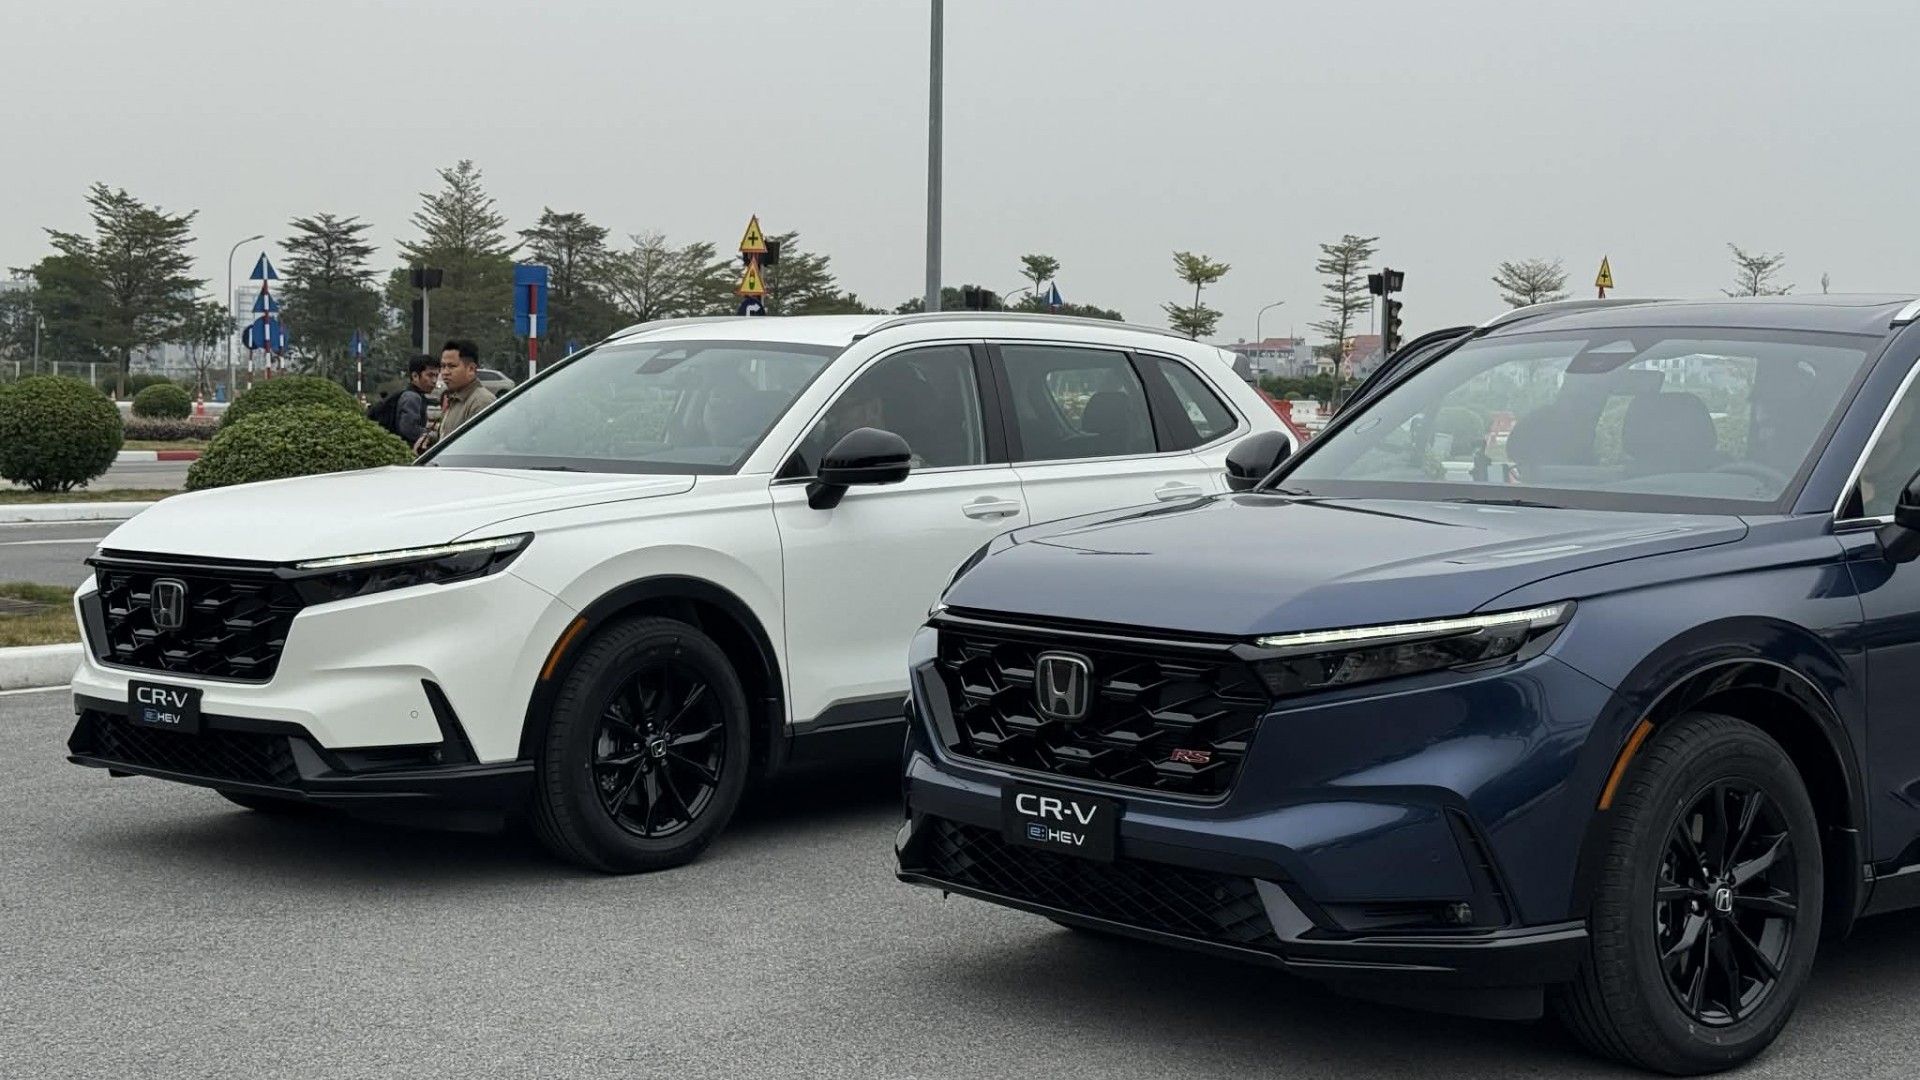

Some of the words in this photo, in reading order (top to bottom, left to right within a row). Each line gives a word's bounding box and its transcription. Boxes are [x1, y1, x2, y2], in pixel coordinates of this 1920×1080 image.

[137, 686, 188, 708] CR-V
[1170, 749, 1211, 764] RS
[1015, 793, 1097, 825] CR-V
